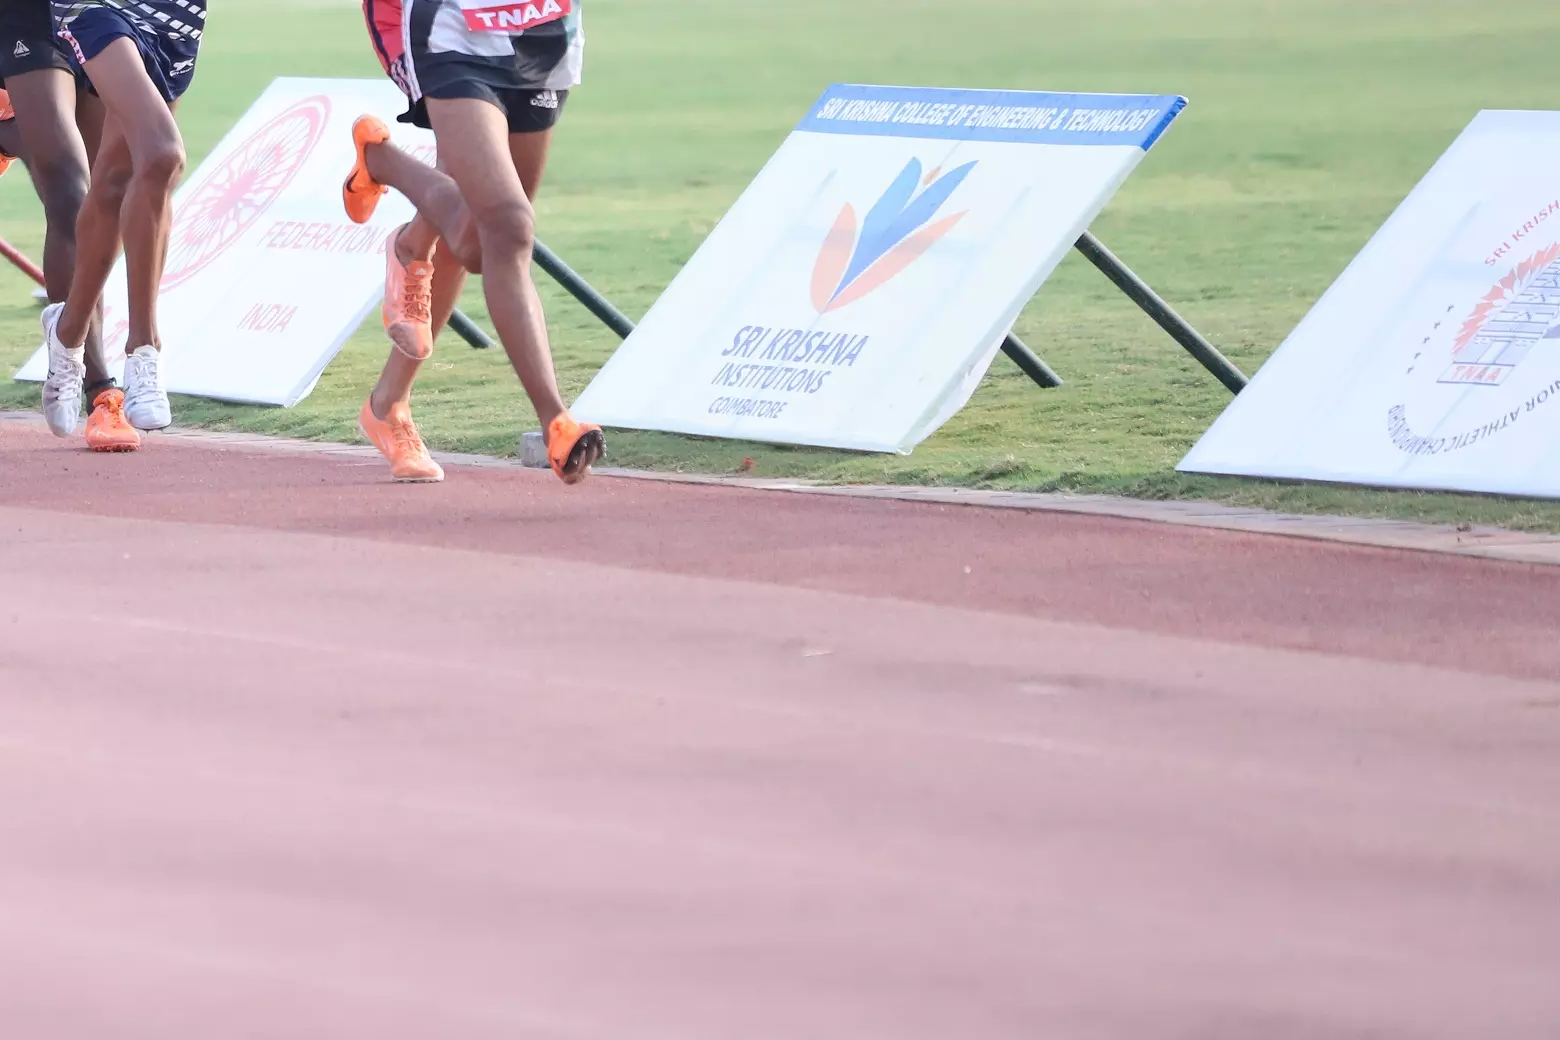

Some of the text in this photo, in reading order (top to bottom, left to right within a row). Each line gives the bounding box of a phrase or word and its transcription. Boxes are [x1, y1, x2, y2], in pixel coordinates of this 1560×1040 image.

[816, 98, 1161, 133] SRI KRISHNA COLLEGE OF ENGINEERING & TECHNOLOGY
[257, 220, 382, 254] FEDERATION
[1484, 241, 1512, 266] SRI
[236, 302, 299, 333] INDIA
[721, 325, 870, 367] SRI KRISHNA
[711, 362, 832, 394] INSTITUTIONS
[1451, 365, 1502, 383] TNAA
[707, 396, 789, 419] COIMBATORE
